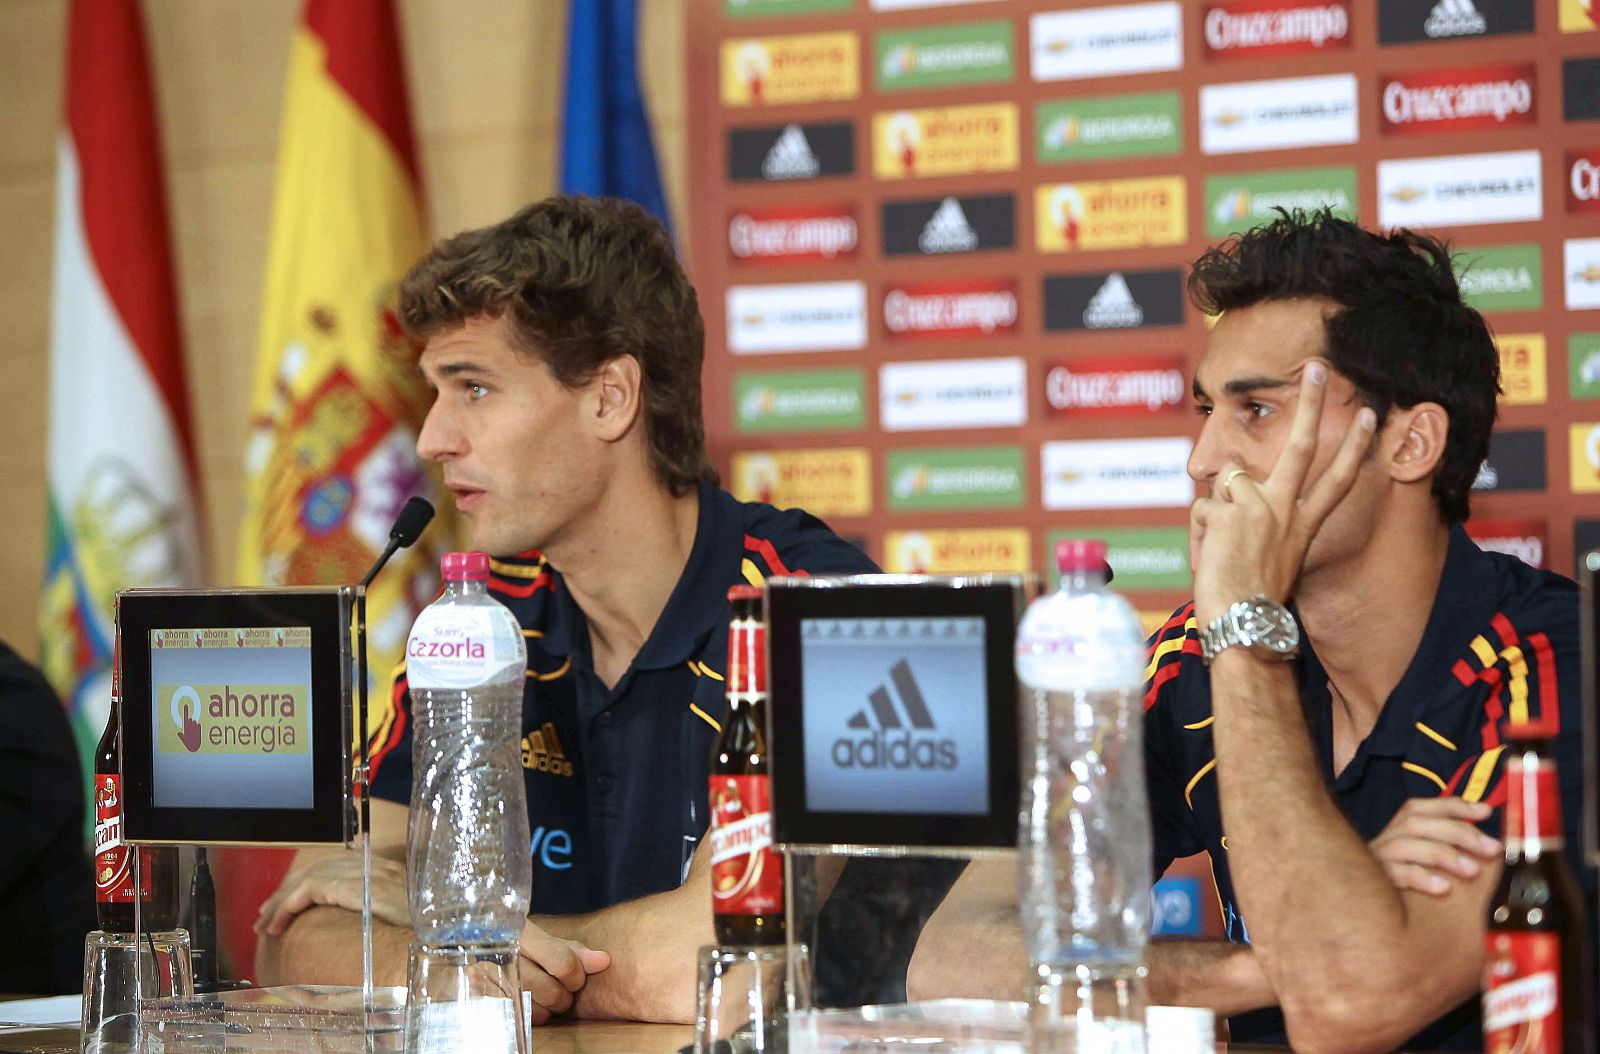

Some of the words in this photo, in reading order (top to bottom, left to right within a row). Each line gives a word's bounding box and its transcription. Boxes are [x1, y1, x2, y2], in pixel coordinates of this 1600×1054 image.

[1205, 5, 1348, 48] Cruzcampo
[1383, 80, 1531, 123] Cruzcampo
[884, 290, 1017, 331] Cruzcampo
[1046, 367, 1184, 411] Cruzcampo
[164, 630, 189, 639] ahorra
[203, 630, 228, 639] ahorra
[408, 636, 485, 658] Cazorla
[208, 685, 295, 718] ahorra
[208, 718, 296, 753] energía
[831, 728, 959, 771] adidas
